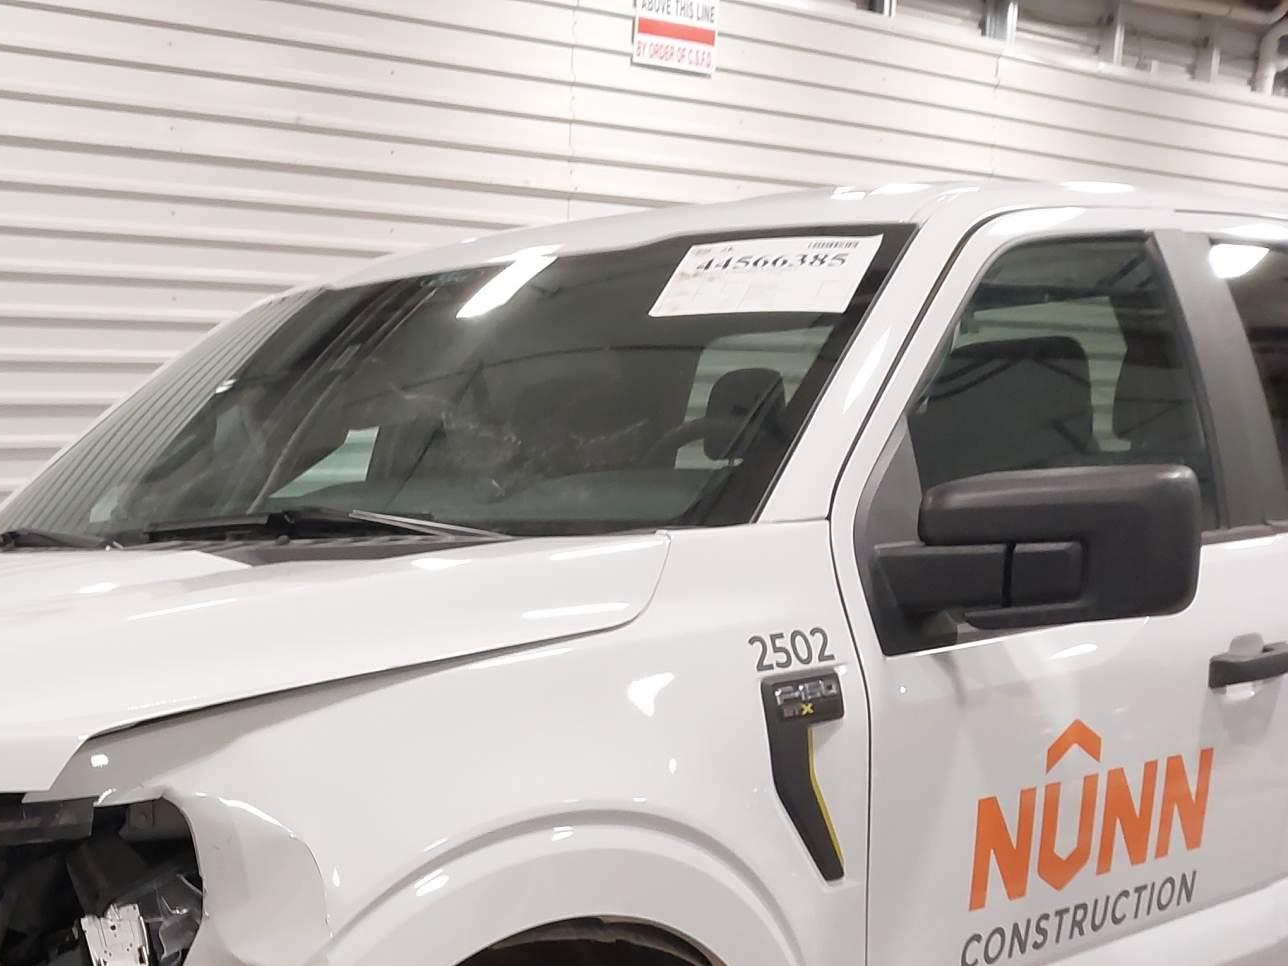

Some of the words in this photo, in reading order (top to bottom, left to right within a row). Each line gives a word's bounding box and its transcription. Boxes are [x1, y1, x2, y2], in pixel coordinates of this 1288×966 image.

[641, 0, 671, 15] ABOVE
[675, 0, 694, 20] THIS
[696, 4, 716, 23] LINE
[636, 40, 647, 57] BY
[649, 41, 675, 62] ORDER
[676, 46, 687, 63] OF
[696, 253, 849, 271] 44566385
[748, 627, 836, 672] 2502
[774, 679, 838, 706] F-150
